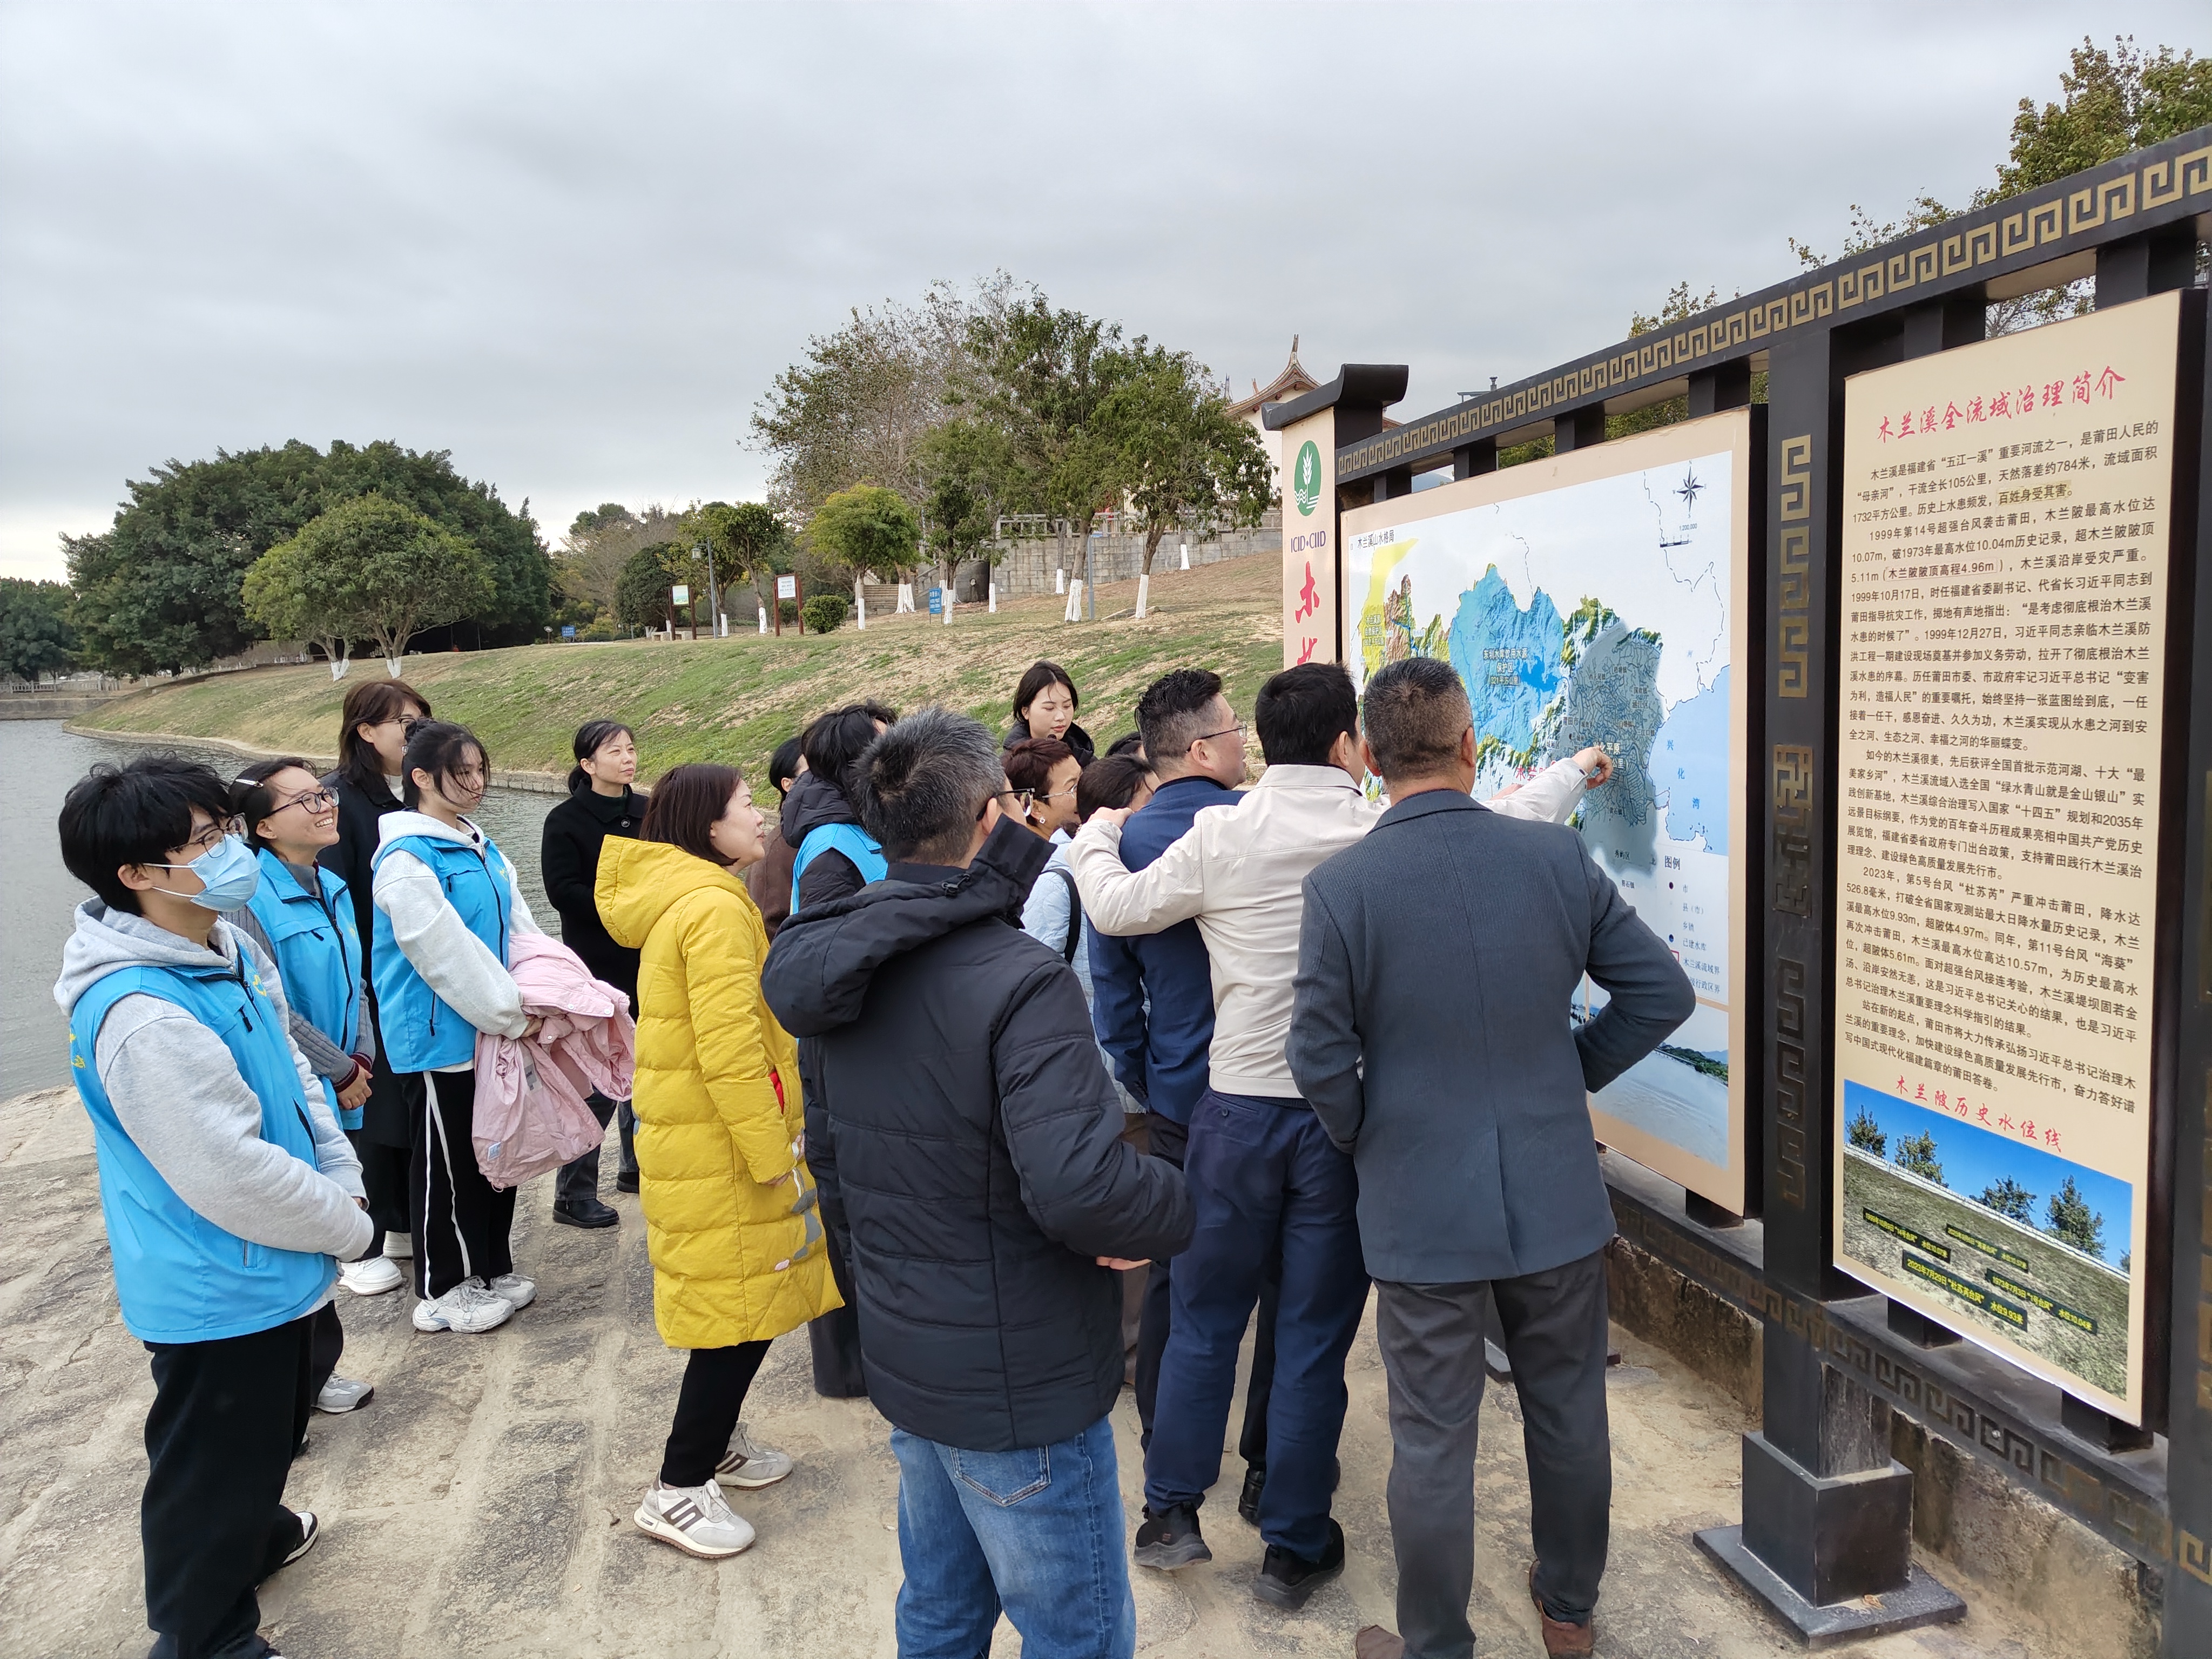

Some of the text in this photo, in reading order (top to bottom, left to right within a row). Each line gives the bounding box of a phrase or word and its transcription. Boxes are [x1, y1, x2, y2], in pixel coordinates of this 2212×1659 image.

[1877, 366, 2126, 443] 木兰溪全流域治理简介
[1357, 530, 1394, 549] 木兰溪山水格局
[1483, 648, 1528, 660] 东圳水库饮用水源
[1496, 662, 1514, 673] 保护区
[1849, 729, 2028, 751] 全之河、生态之河、幸福之河的华丽蝶变。
[1664, 855, 1681, 870] 图例
[1847, 845, 2002, 880] 理理念、建设绿色高质量发展先行市。
[1845, 976, 2032, 1038] 总书记治理木兰溪重要理念科学指引的结果。
[1845, 1032, 1998, 1092] 写中国式现代化福建篇章的莆田答卷。
[1896, 1075, 2062, 1153] 木兰陂历史水位线
